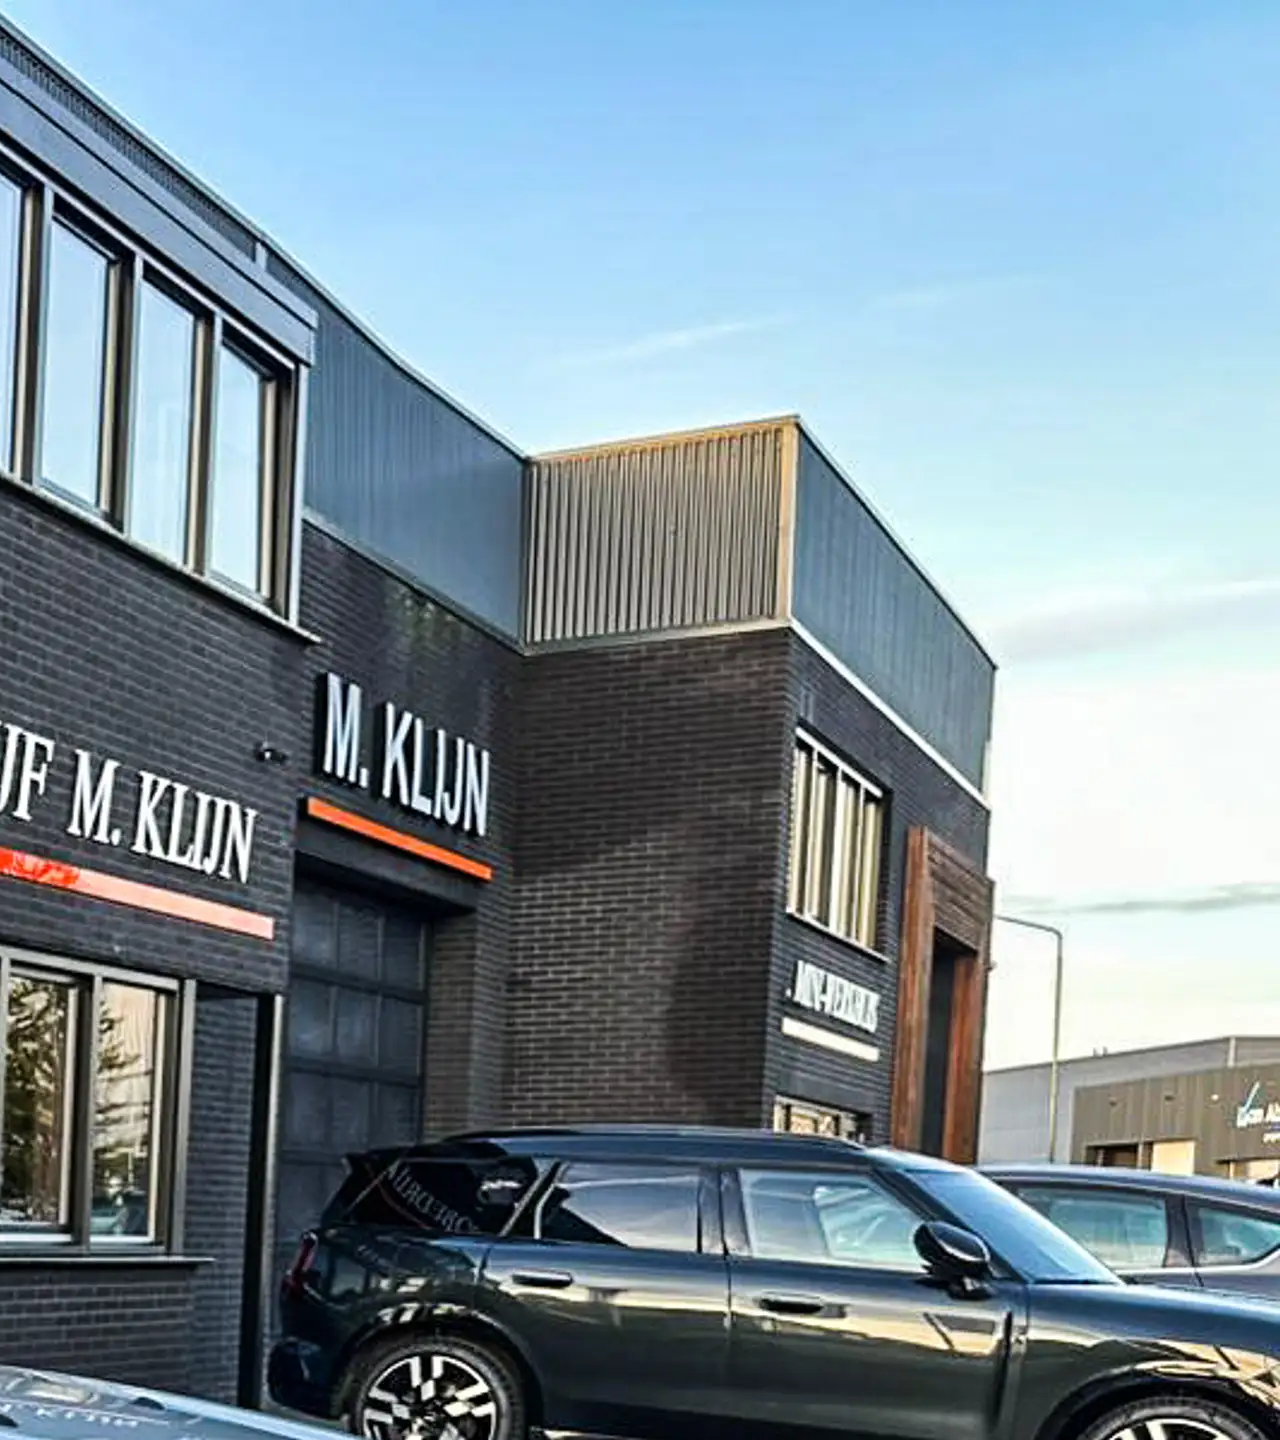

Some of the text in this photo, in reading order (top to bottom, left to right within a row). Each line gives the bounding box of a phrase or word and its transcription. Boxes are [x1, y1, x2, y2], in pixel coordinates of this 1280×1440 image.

[67, 748, 122, 846] M.
[130, 770, 259, 885] KLIJN
[322, 671, 491, 838] M. KLIJN
